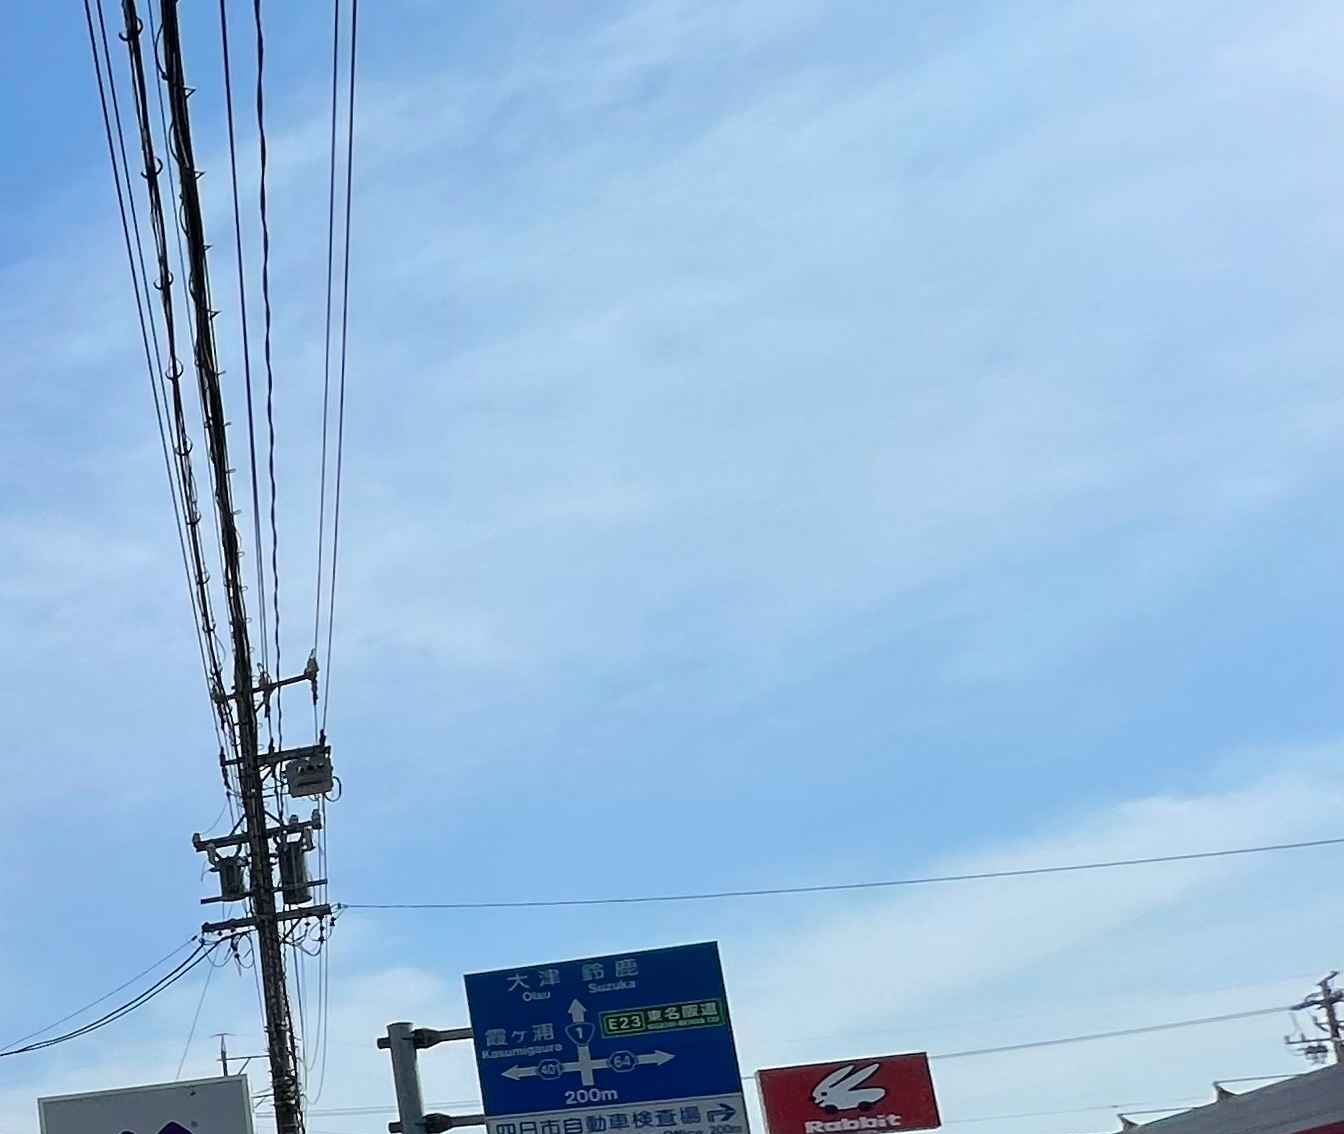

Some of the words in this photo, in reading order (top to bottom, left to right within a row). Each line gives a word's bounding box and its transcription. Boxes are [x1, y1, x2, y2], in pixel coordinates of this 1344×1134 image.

[506, 968, 560, 991] 大津
[608, 1015, 642, 1031] E23
[613, 1055, 631, 1068] 64
[564, 1088, 618, 1105] 200m
[804, 1114, 902, 1134] Rabbit
